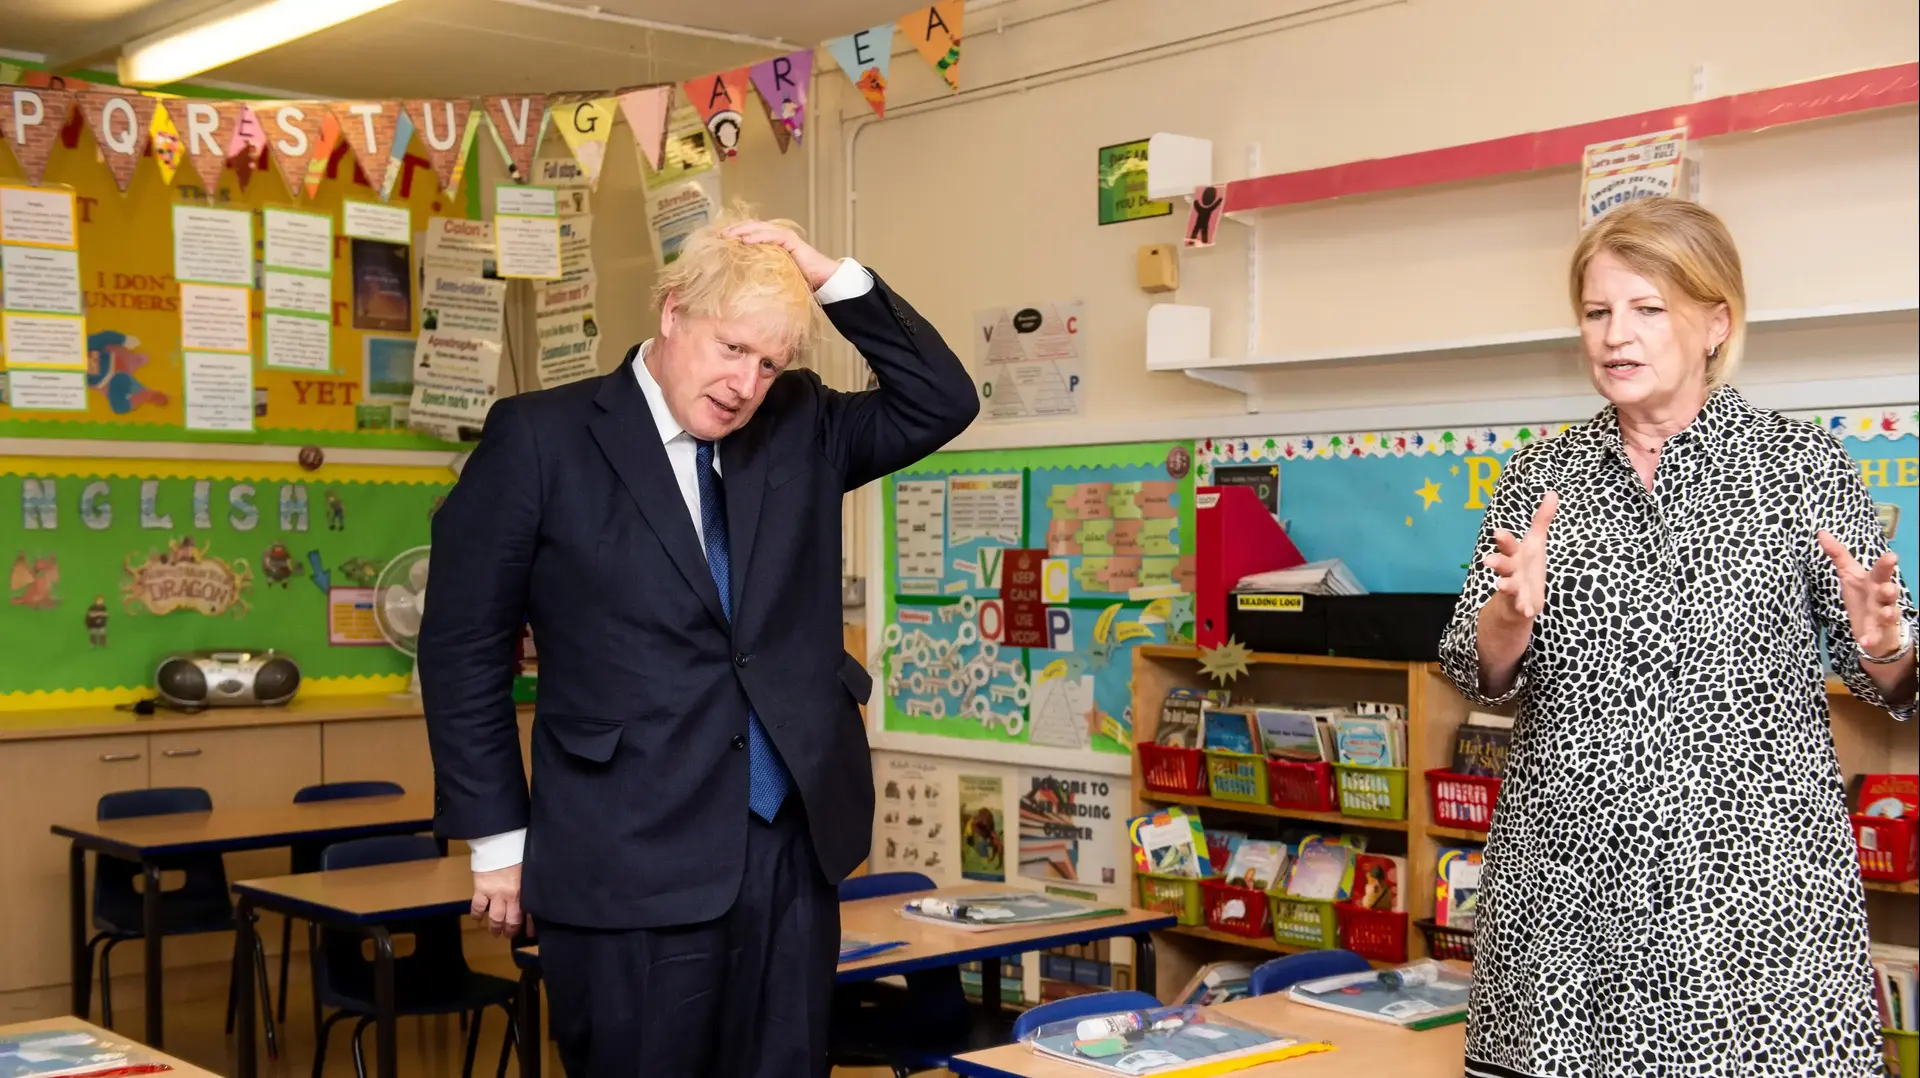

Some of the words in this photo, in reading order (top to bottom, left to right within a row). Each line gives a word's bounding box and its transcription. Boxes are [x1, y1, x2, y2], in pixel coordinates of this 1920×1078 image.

[709, 74, 732, 109] A
[773, 56, 796, 91] R
[853, 29, 875, 65] E
[926, 6, 950, 42] A
[12, 90, 44, 145] P
[102, 97, 138, 156] Q
[186, 102, 223, 157] R
[276, 105, 309, 157] S
[349, 103, 383, 155] T
[423, 102, 458, 151] U
[500, 97, 530, 146] V
[574, 102, 599, 134] G
[983, 325, 994, 343] V
[1067, 316, 1078, 334] C
[292, 380, 360, 406] YET
[1069, 375, 1080, 393] P
[979, 549, 1002, 588] V
[1012, 571, 1036, 584] KEEP
[1044, 561, 1067, 603] C
[1010, 589, 1038, 602] CALM
[1239, 597, 1277, 607] READING
[1047, 609, 1071, 650] P
[1460, 739, 1482, 754] Hat
[1091, 782, 1109, 796] TO
